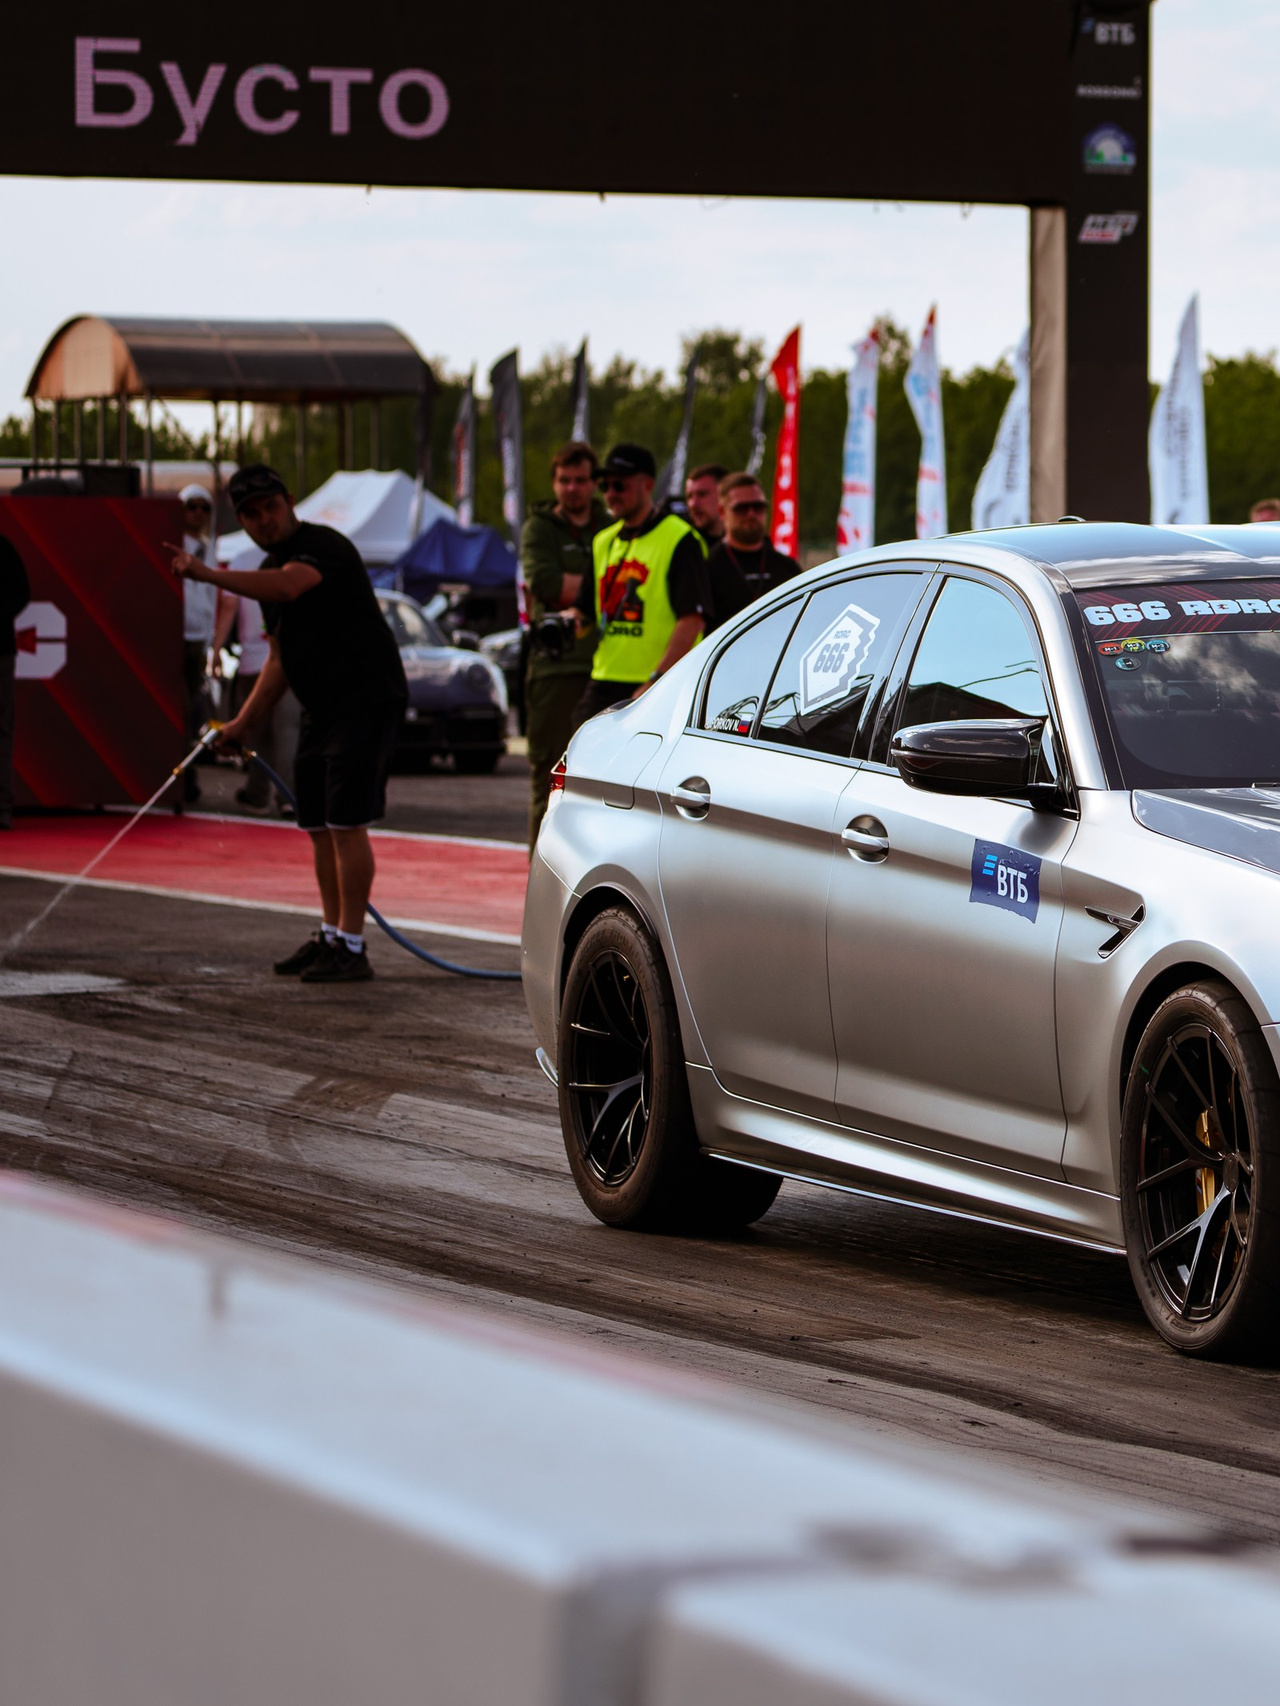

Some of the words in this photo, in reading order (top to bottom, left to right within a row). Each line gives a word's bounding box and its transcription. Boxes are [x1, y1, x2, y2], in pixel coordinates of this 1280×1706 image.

[75, 36, 450, 146] Бусто
[1083, 600, 1172, 626] 666
[813, 642, 850, 673] 666
[997, 864, 1029, 904] ВТБ
